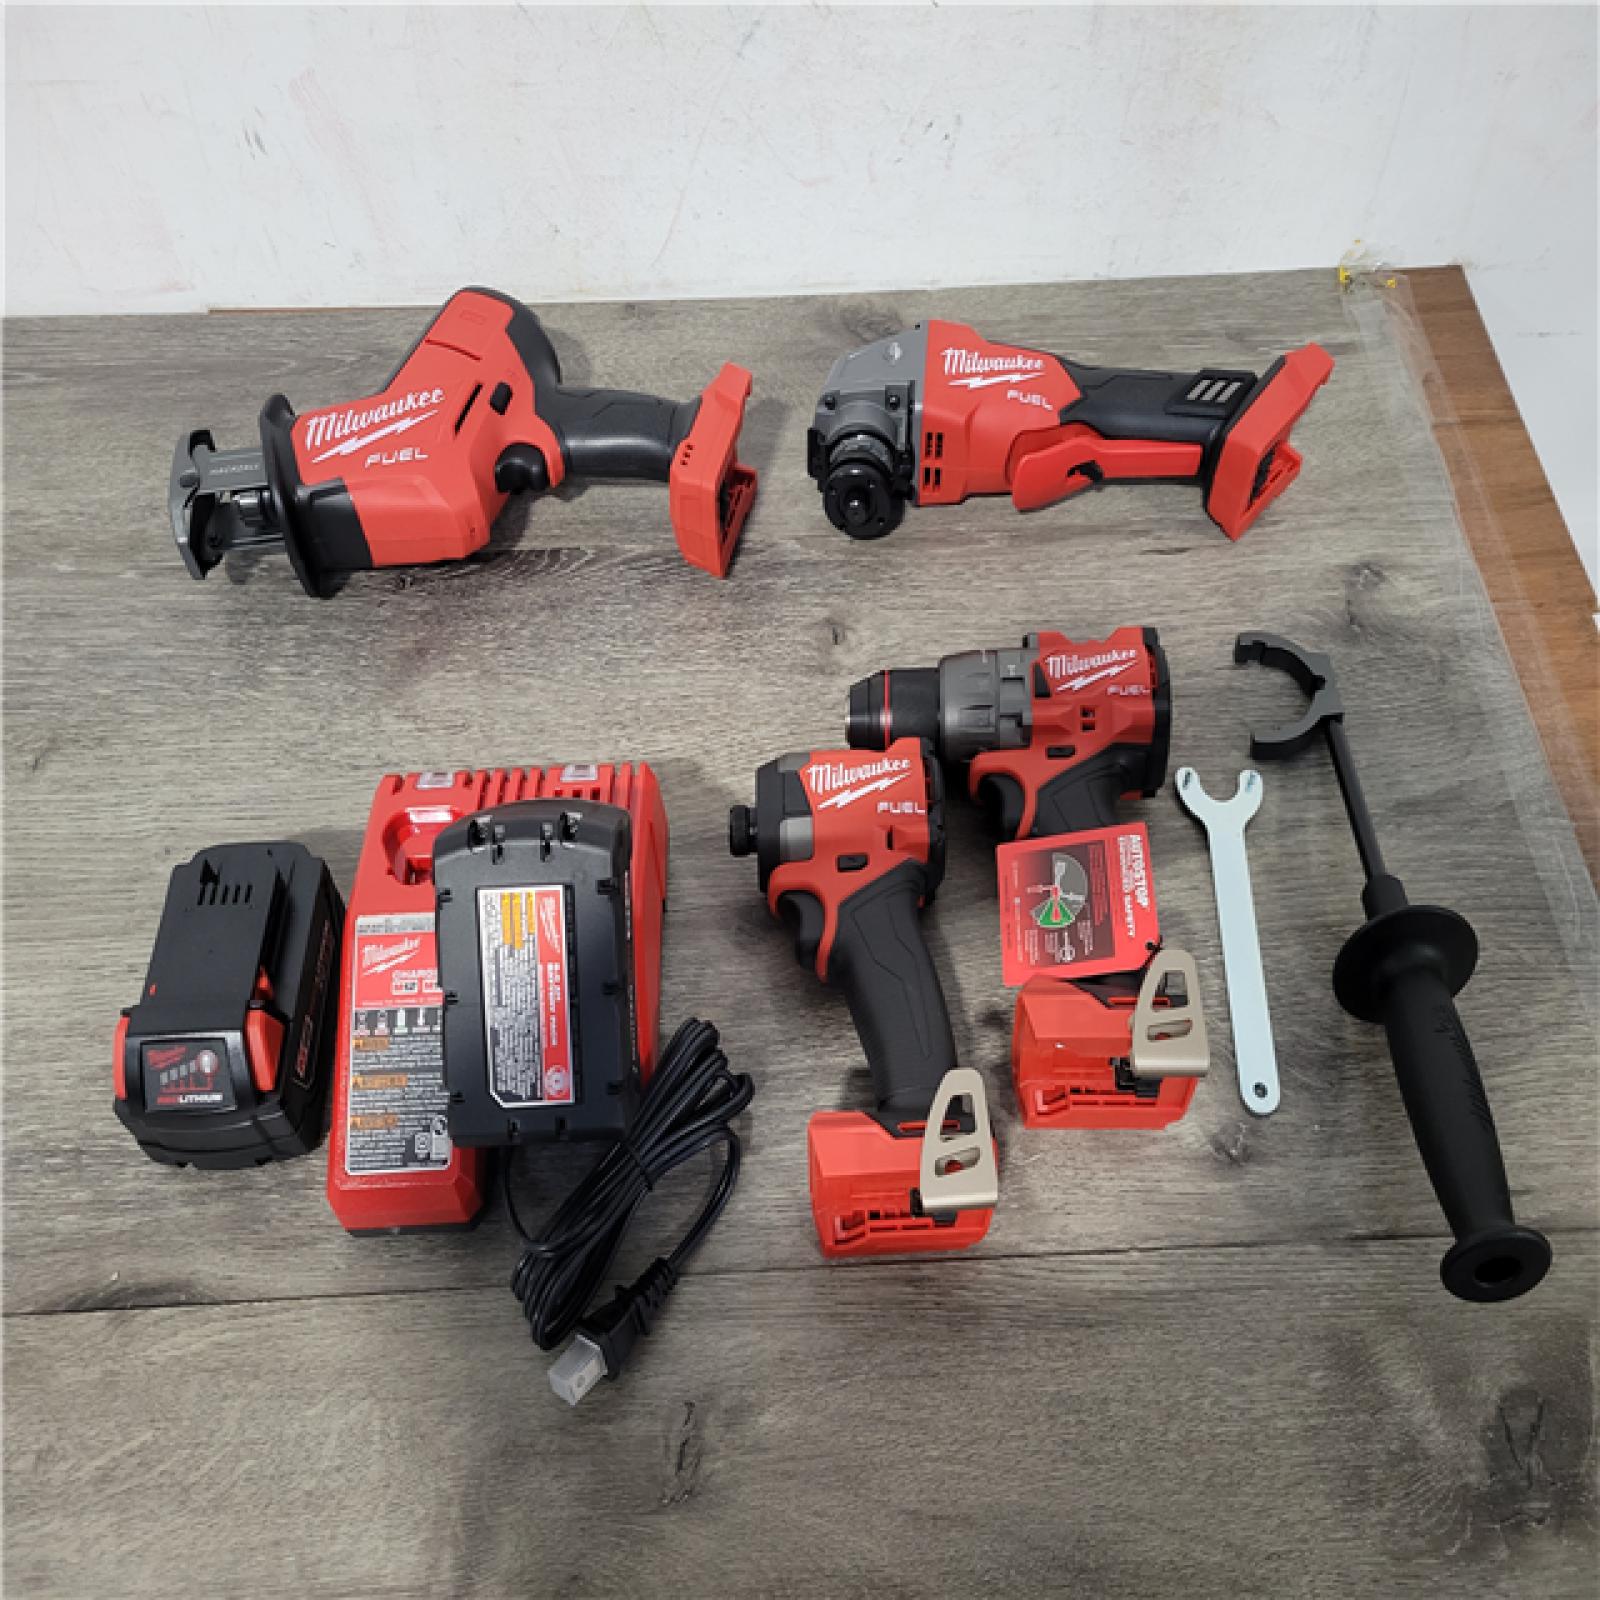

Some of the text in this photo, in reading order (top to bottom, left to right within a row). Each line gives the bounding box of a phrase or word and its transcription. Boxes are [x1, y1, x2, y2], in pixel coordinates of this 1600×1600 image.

[940, 348, 1045, 376] Milwaukee
[1007, 389, 1053, 411] FUEL
[304, 387, 445, 451] Milwaukee
[364, 447, 429, 468] FUEL
[1044, 649, 1137, 679] Milwaukee
[1106, 684, 1151, 696] FUEL
[806, 757, 911, 795] Milwaukee
[877, 801, 926, 814] FUEL
